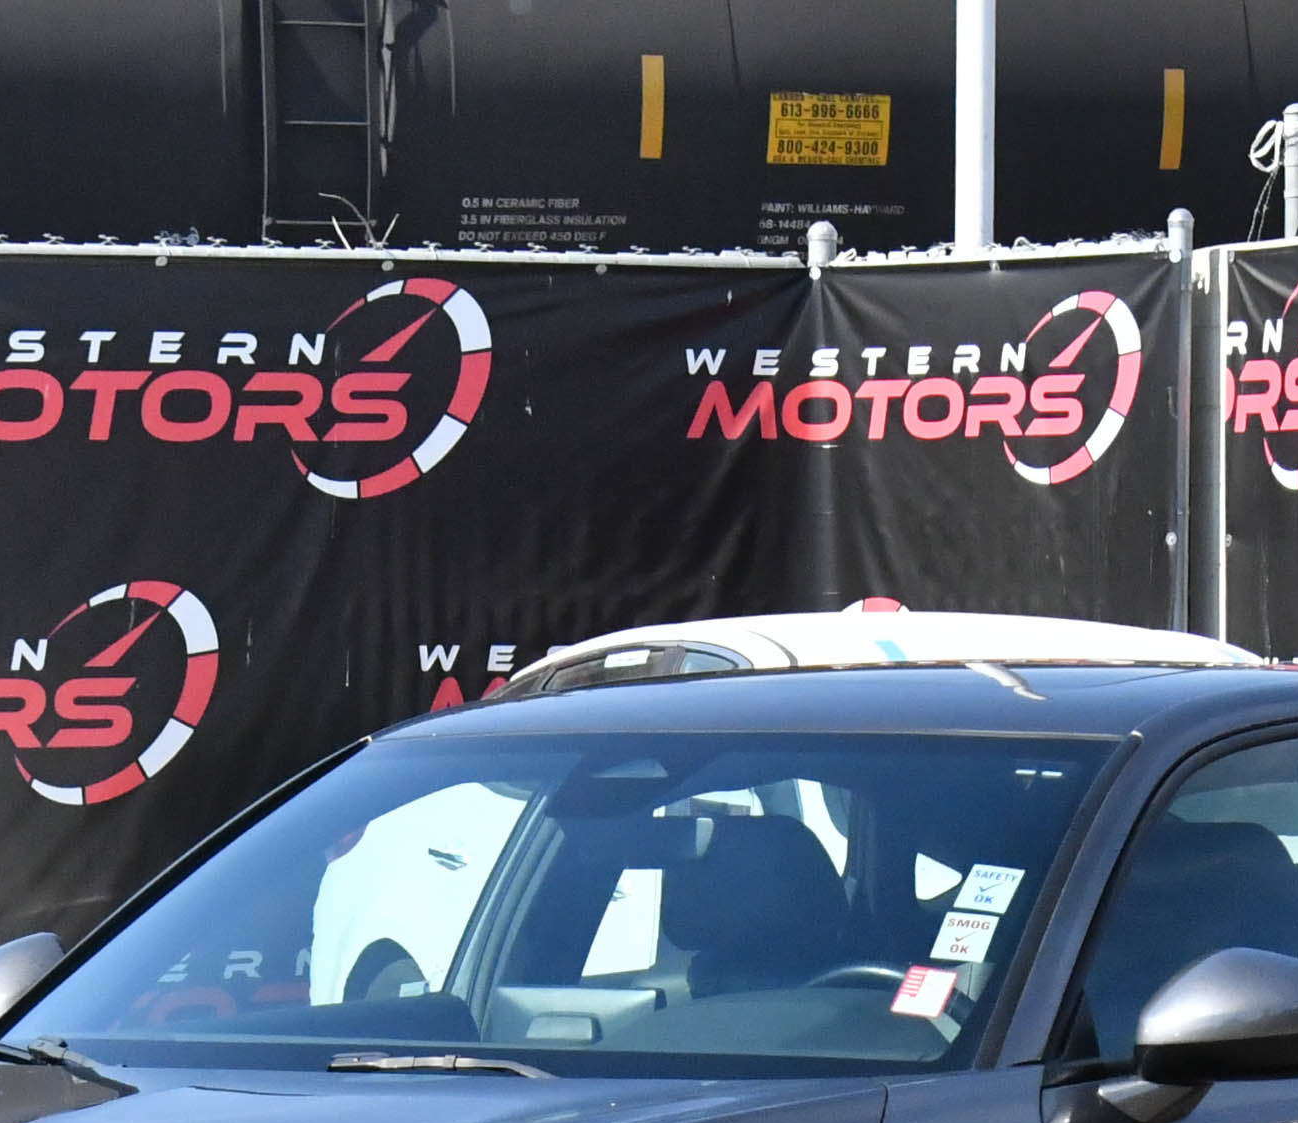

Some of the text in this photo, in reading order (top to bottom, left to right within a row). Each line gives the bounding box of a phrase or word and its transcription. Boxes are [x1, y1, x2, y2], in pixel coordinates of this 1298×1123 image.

[780, 102, 880, 120] 613-996-6666
[777, 139, 879, 155] 800-424-9300
[461, 197, 581, 209] 0.5 IN CERAMIC FIBER
[460, 214, 627, 226] 3.5 IN FIBERGLASS INSULATION
[458, 231, 476, 242] DO
[477, 231, 501, 242] NOT
[503, 231, 548, 242] EXCEED
[573, 231, 598, 242] DEG
[686, 342, 1027, 377] WESTERN
[687, 374, 1086, 441] MOTORS
[972, 869, 1019, 883] SAFETY
[974, 894, 994, 905] OK
[947, 917, 991, 931] SMOG
[949, 944, 970, 955] OK
